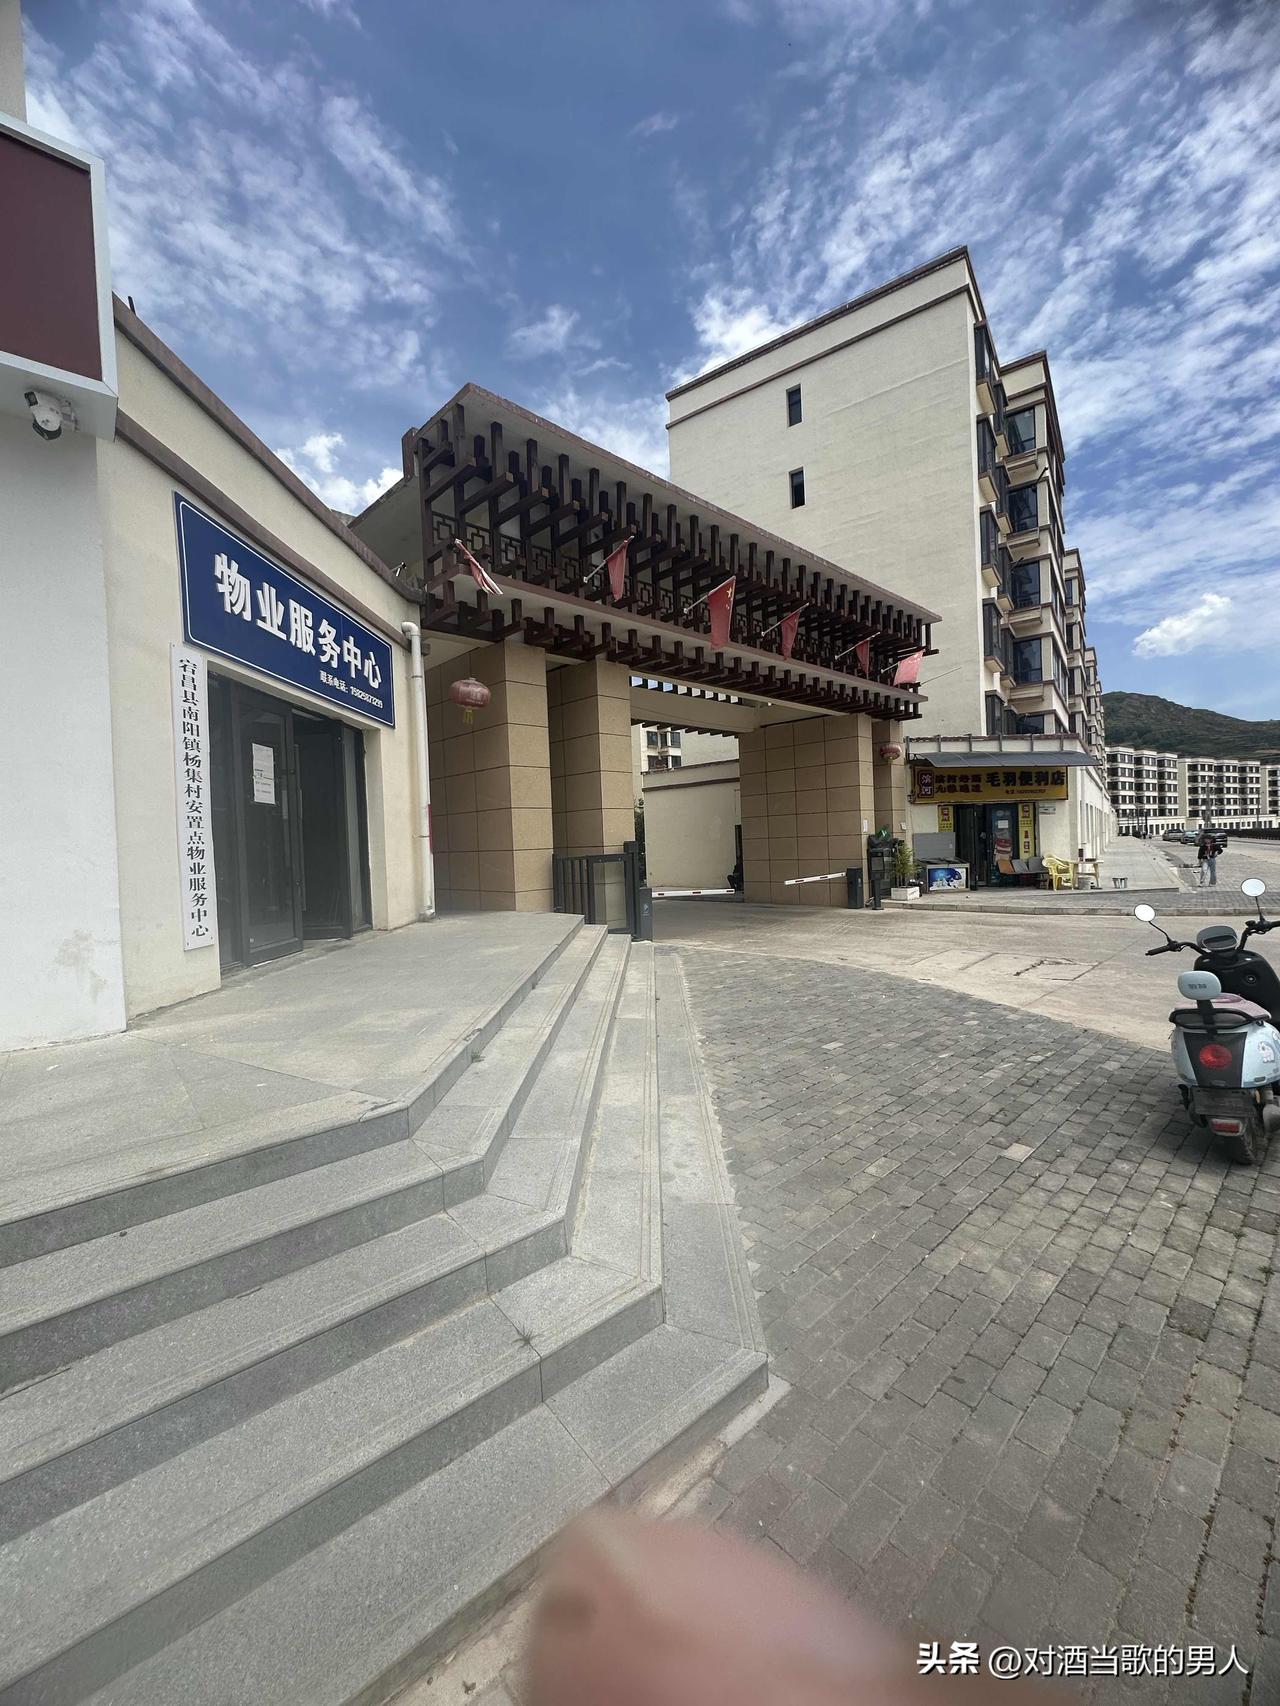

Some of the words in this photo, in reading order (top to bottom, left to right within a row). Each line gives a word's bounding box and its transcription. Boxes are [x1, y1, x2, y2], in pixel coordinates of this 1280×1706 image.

[214, 552, 382, 689] 物业服务中心
[178, 658, 209, 937] 宕昌县南阳镇杨集村安置点物业服务中心
